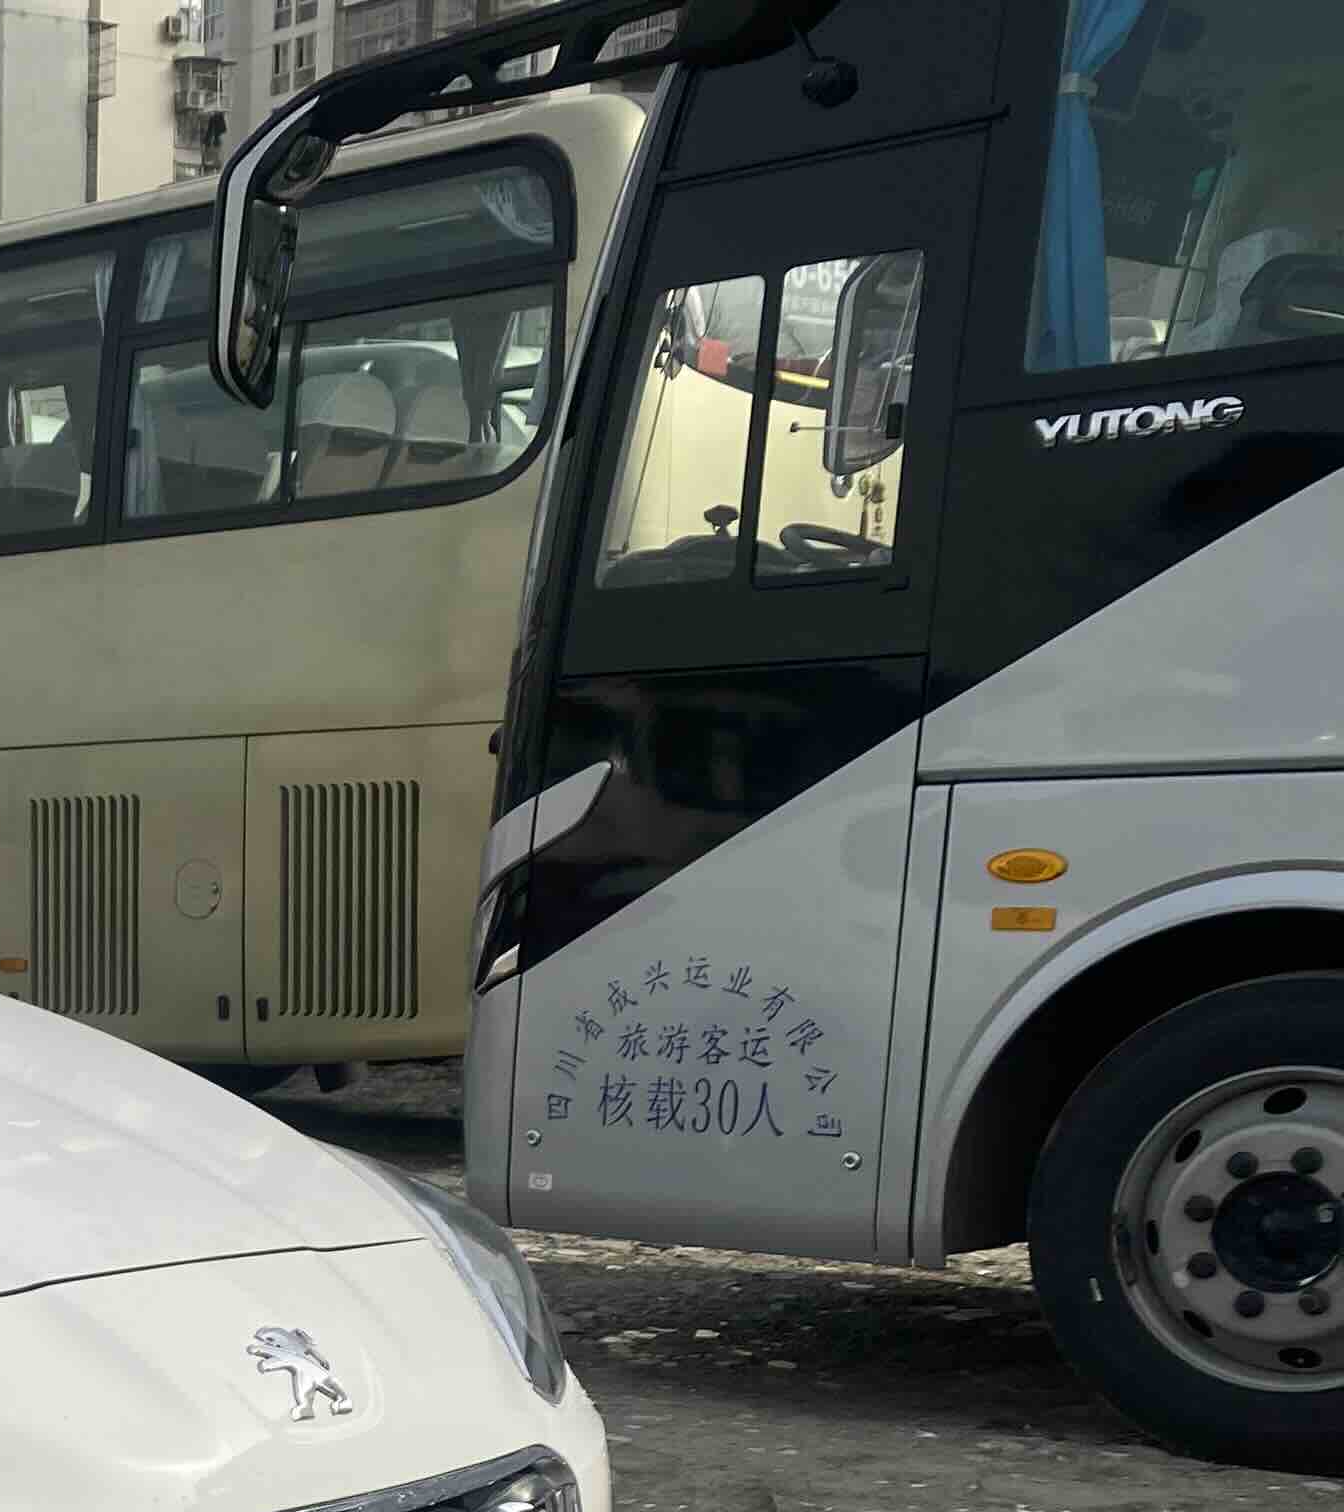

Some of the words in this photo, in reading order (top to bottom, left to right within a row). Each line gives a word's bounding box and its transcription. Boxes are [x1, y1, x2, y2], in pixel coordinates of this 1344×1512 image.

[1034, 396, 1245, 448] YUTONG
[615, 1022, 774, 1068] 旅游客运
[597, 1072, 784, 1137] 核载30人
